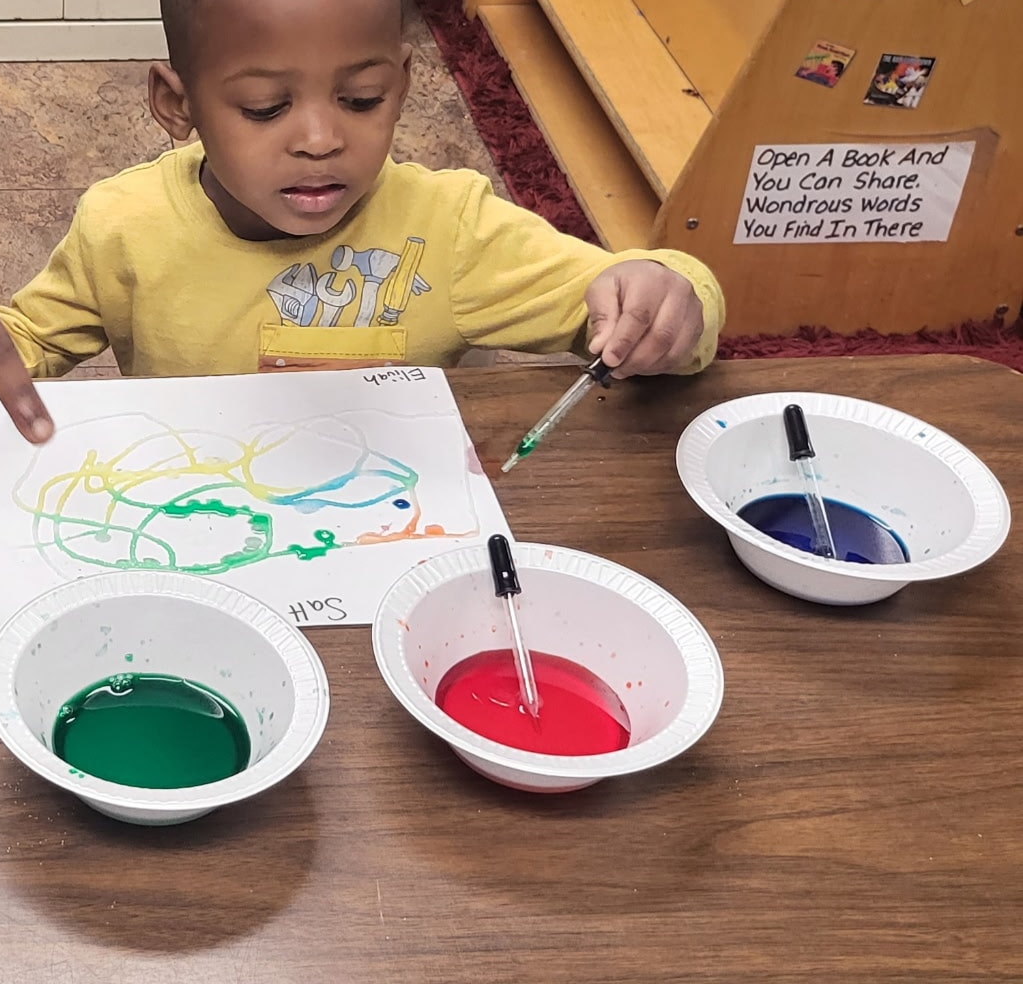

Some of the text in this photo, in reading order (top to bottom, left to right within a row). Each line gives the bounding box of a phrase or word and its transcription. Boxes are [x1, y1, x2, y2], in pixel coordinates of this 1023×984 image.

[757, 148, 810, 170] Open
[816, 148, 835, 167] A
[897, 145, 950, 166] And
[752, 171, 791, 191] You
[798, 172, 843, 190] Can
[745, 195, 853, 215] Wondrous
[743, 218, 924, 239] You Find In There
[288, 597, 347, 622] Salt
